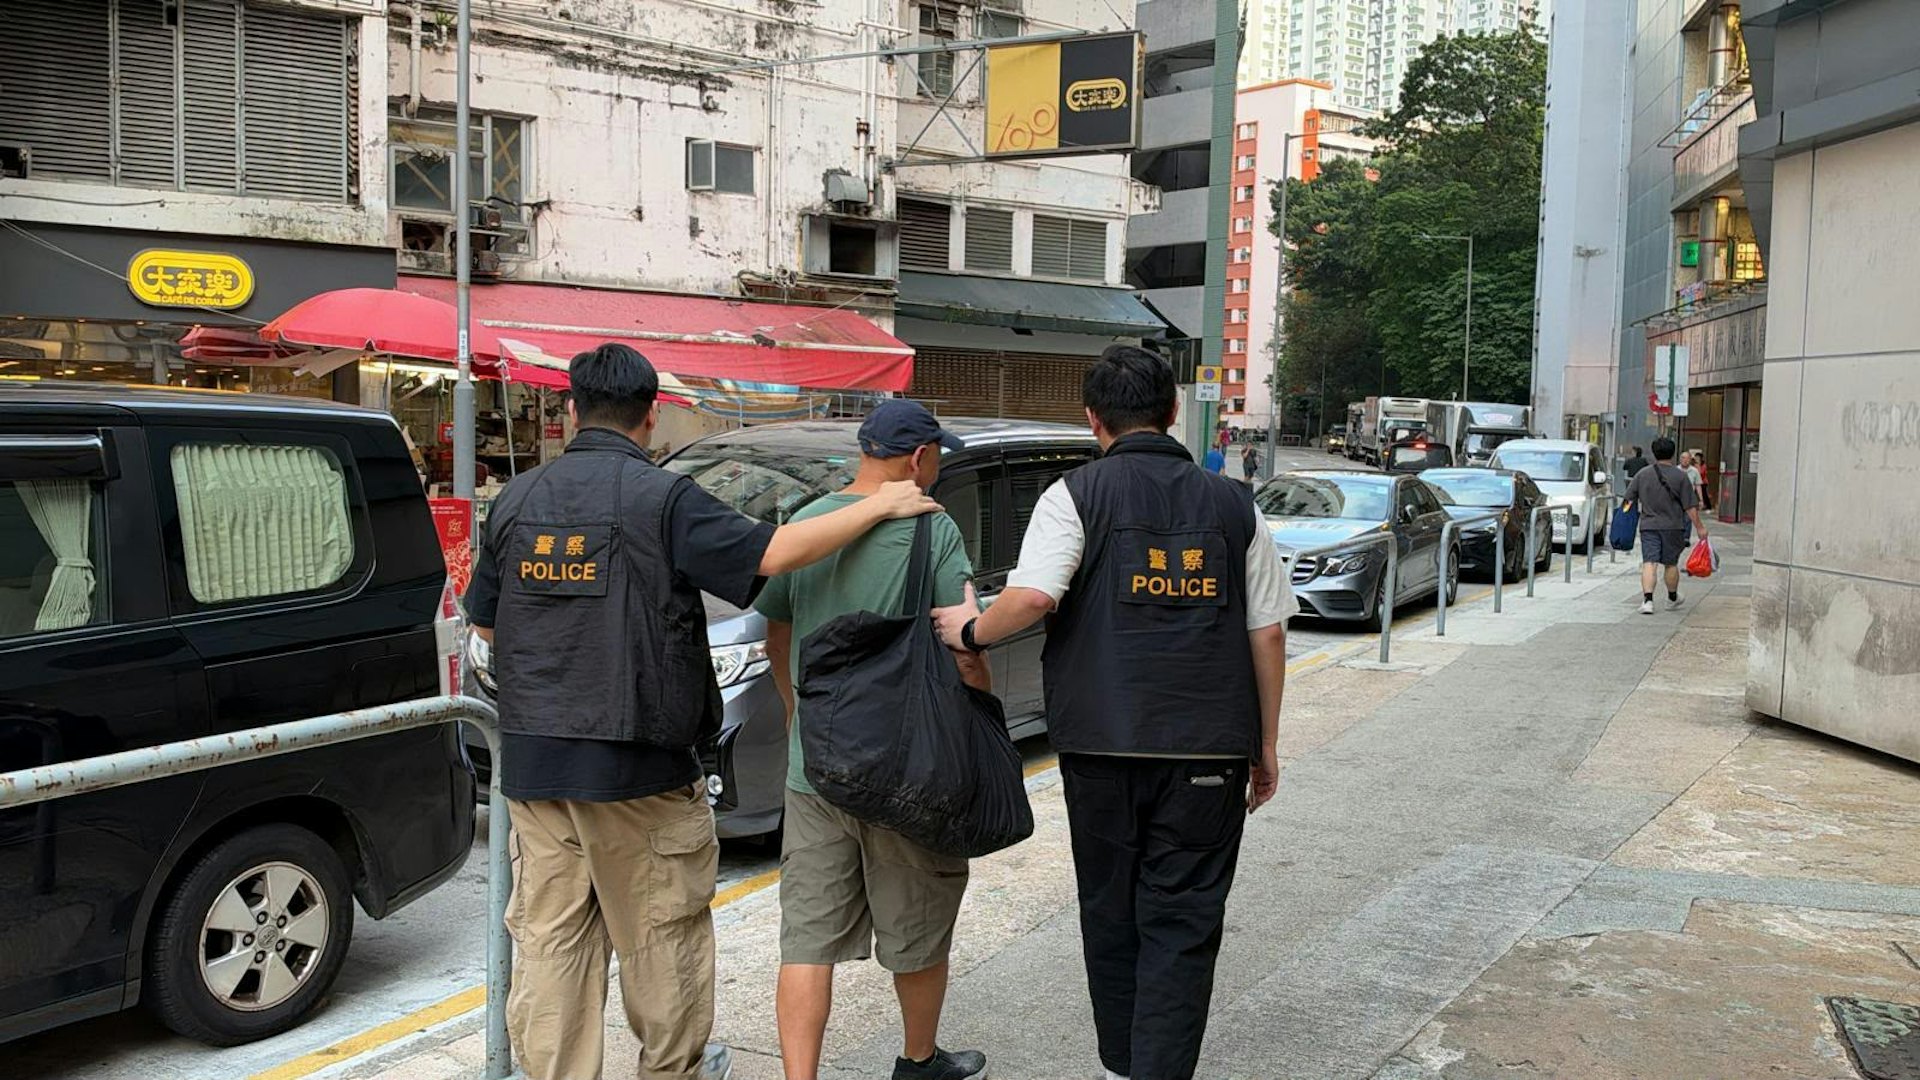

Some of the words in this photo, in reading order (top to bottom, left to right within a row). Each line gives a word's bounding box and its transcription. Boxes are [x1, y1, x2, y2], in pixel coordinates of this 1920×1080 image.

[534, 534, 585, 556] 警察
[521, 561, 596, 580] POLICE
[1148, 548, 1204, 571] 警察
[1132, 575, 1217, 597] POLICE
